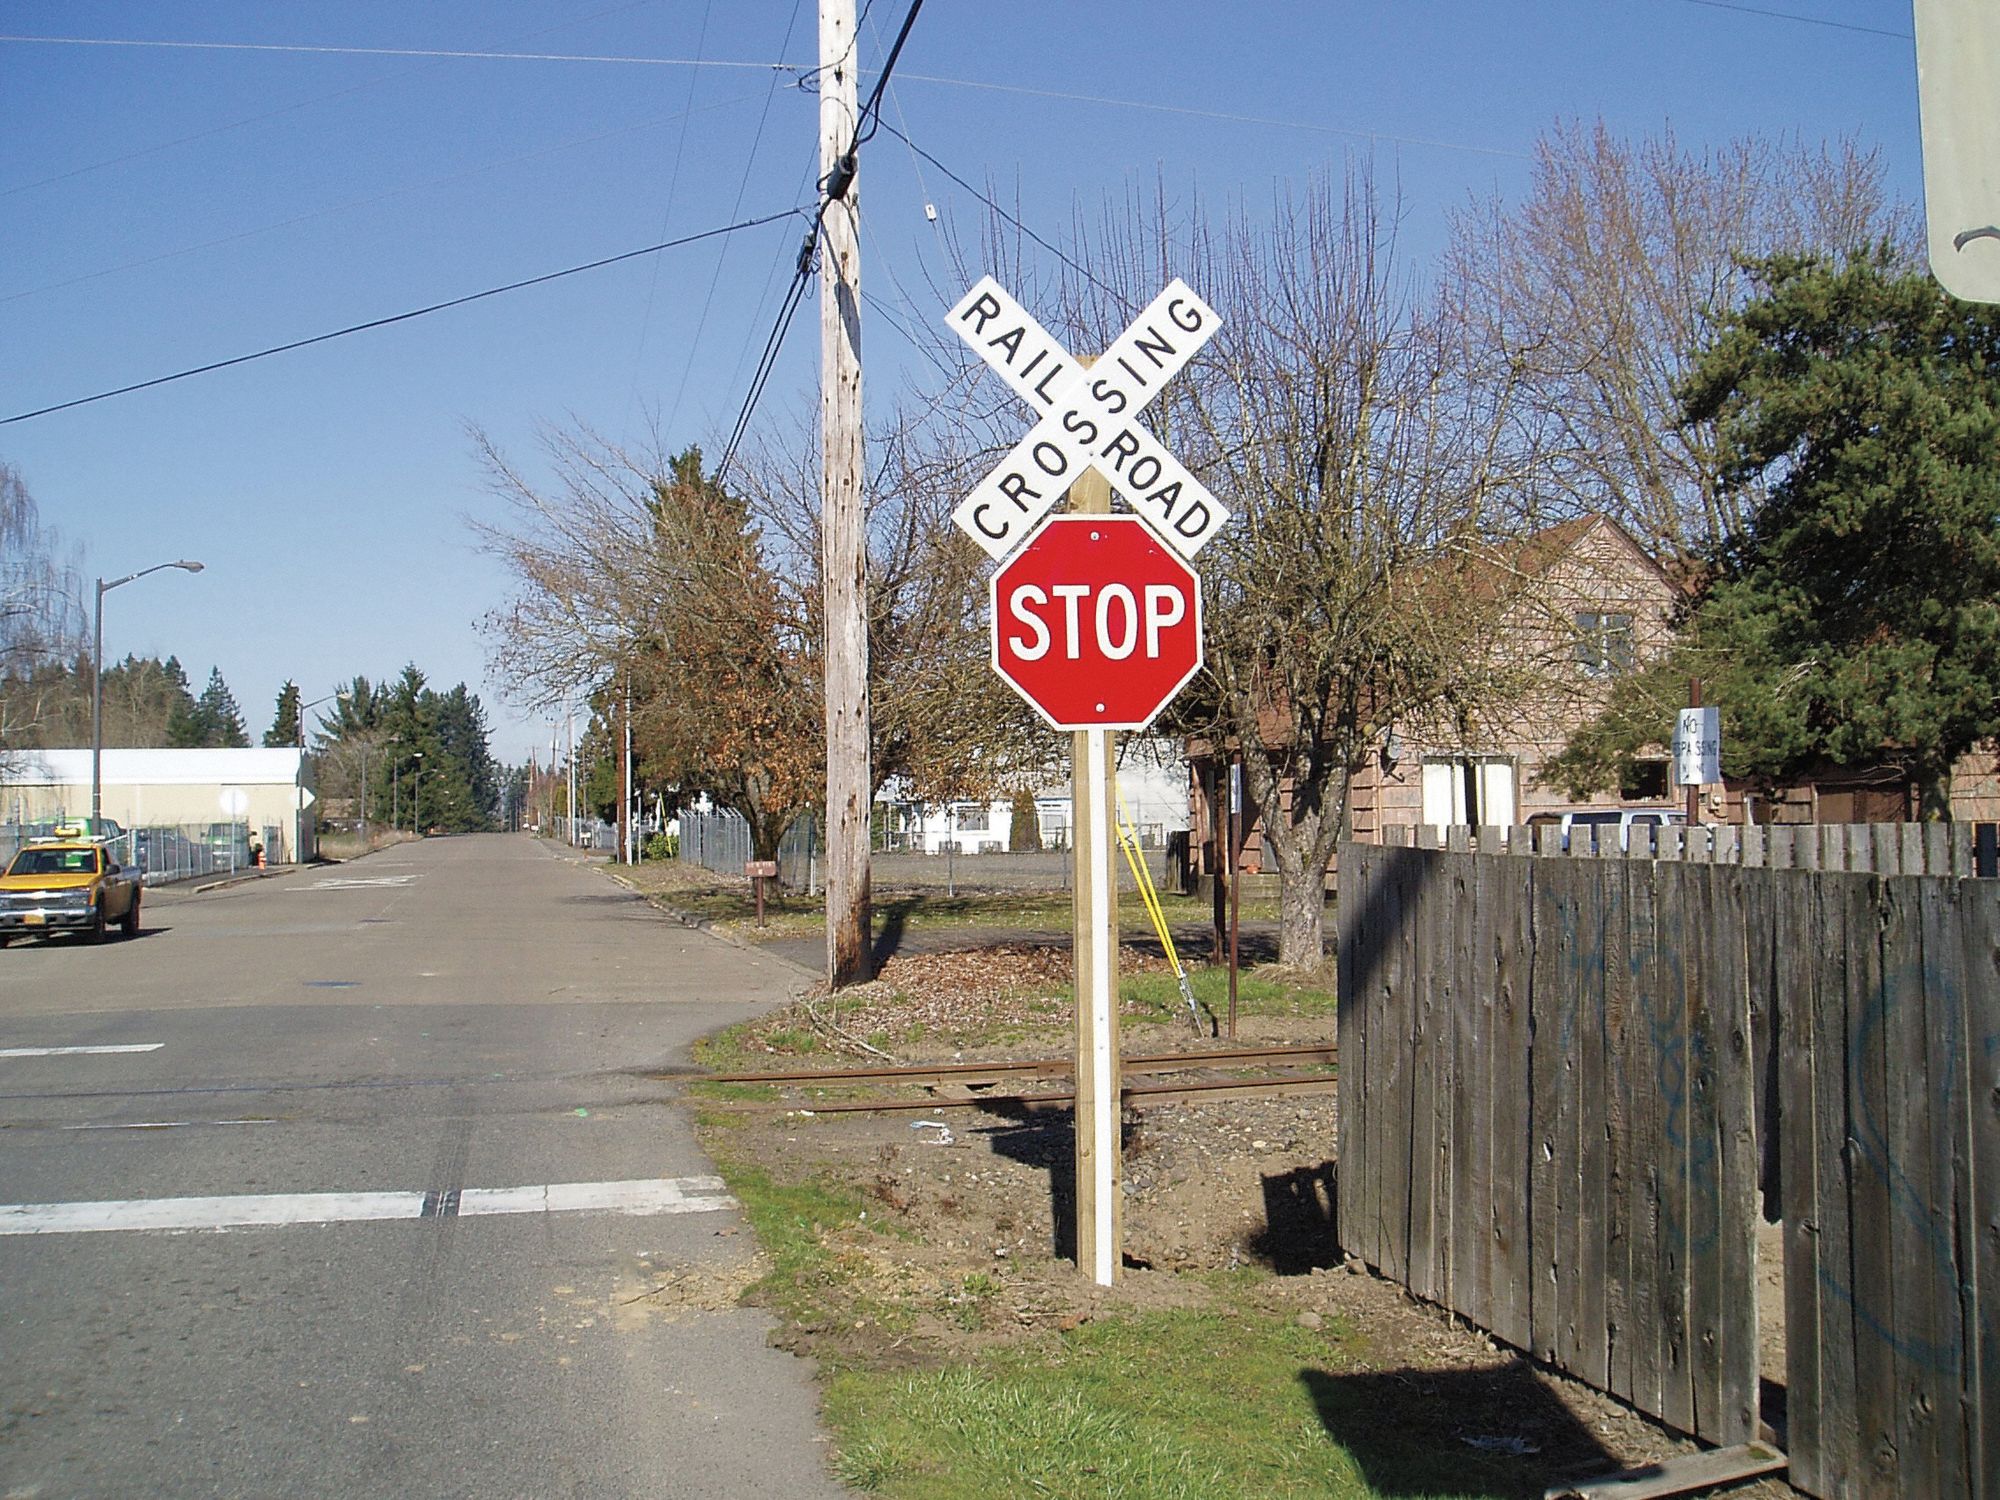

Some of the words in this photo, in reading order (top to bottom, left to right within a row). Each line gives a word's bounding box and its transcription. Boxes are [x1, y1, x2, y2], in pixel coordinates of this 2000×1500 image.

[962, 292, 1054, 405] RAIL
[1101, 429, 1211, 538] ROAD
[974, 298, 1203, 540] CROSSING
[1008, 583, 1186, 662] STOP
